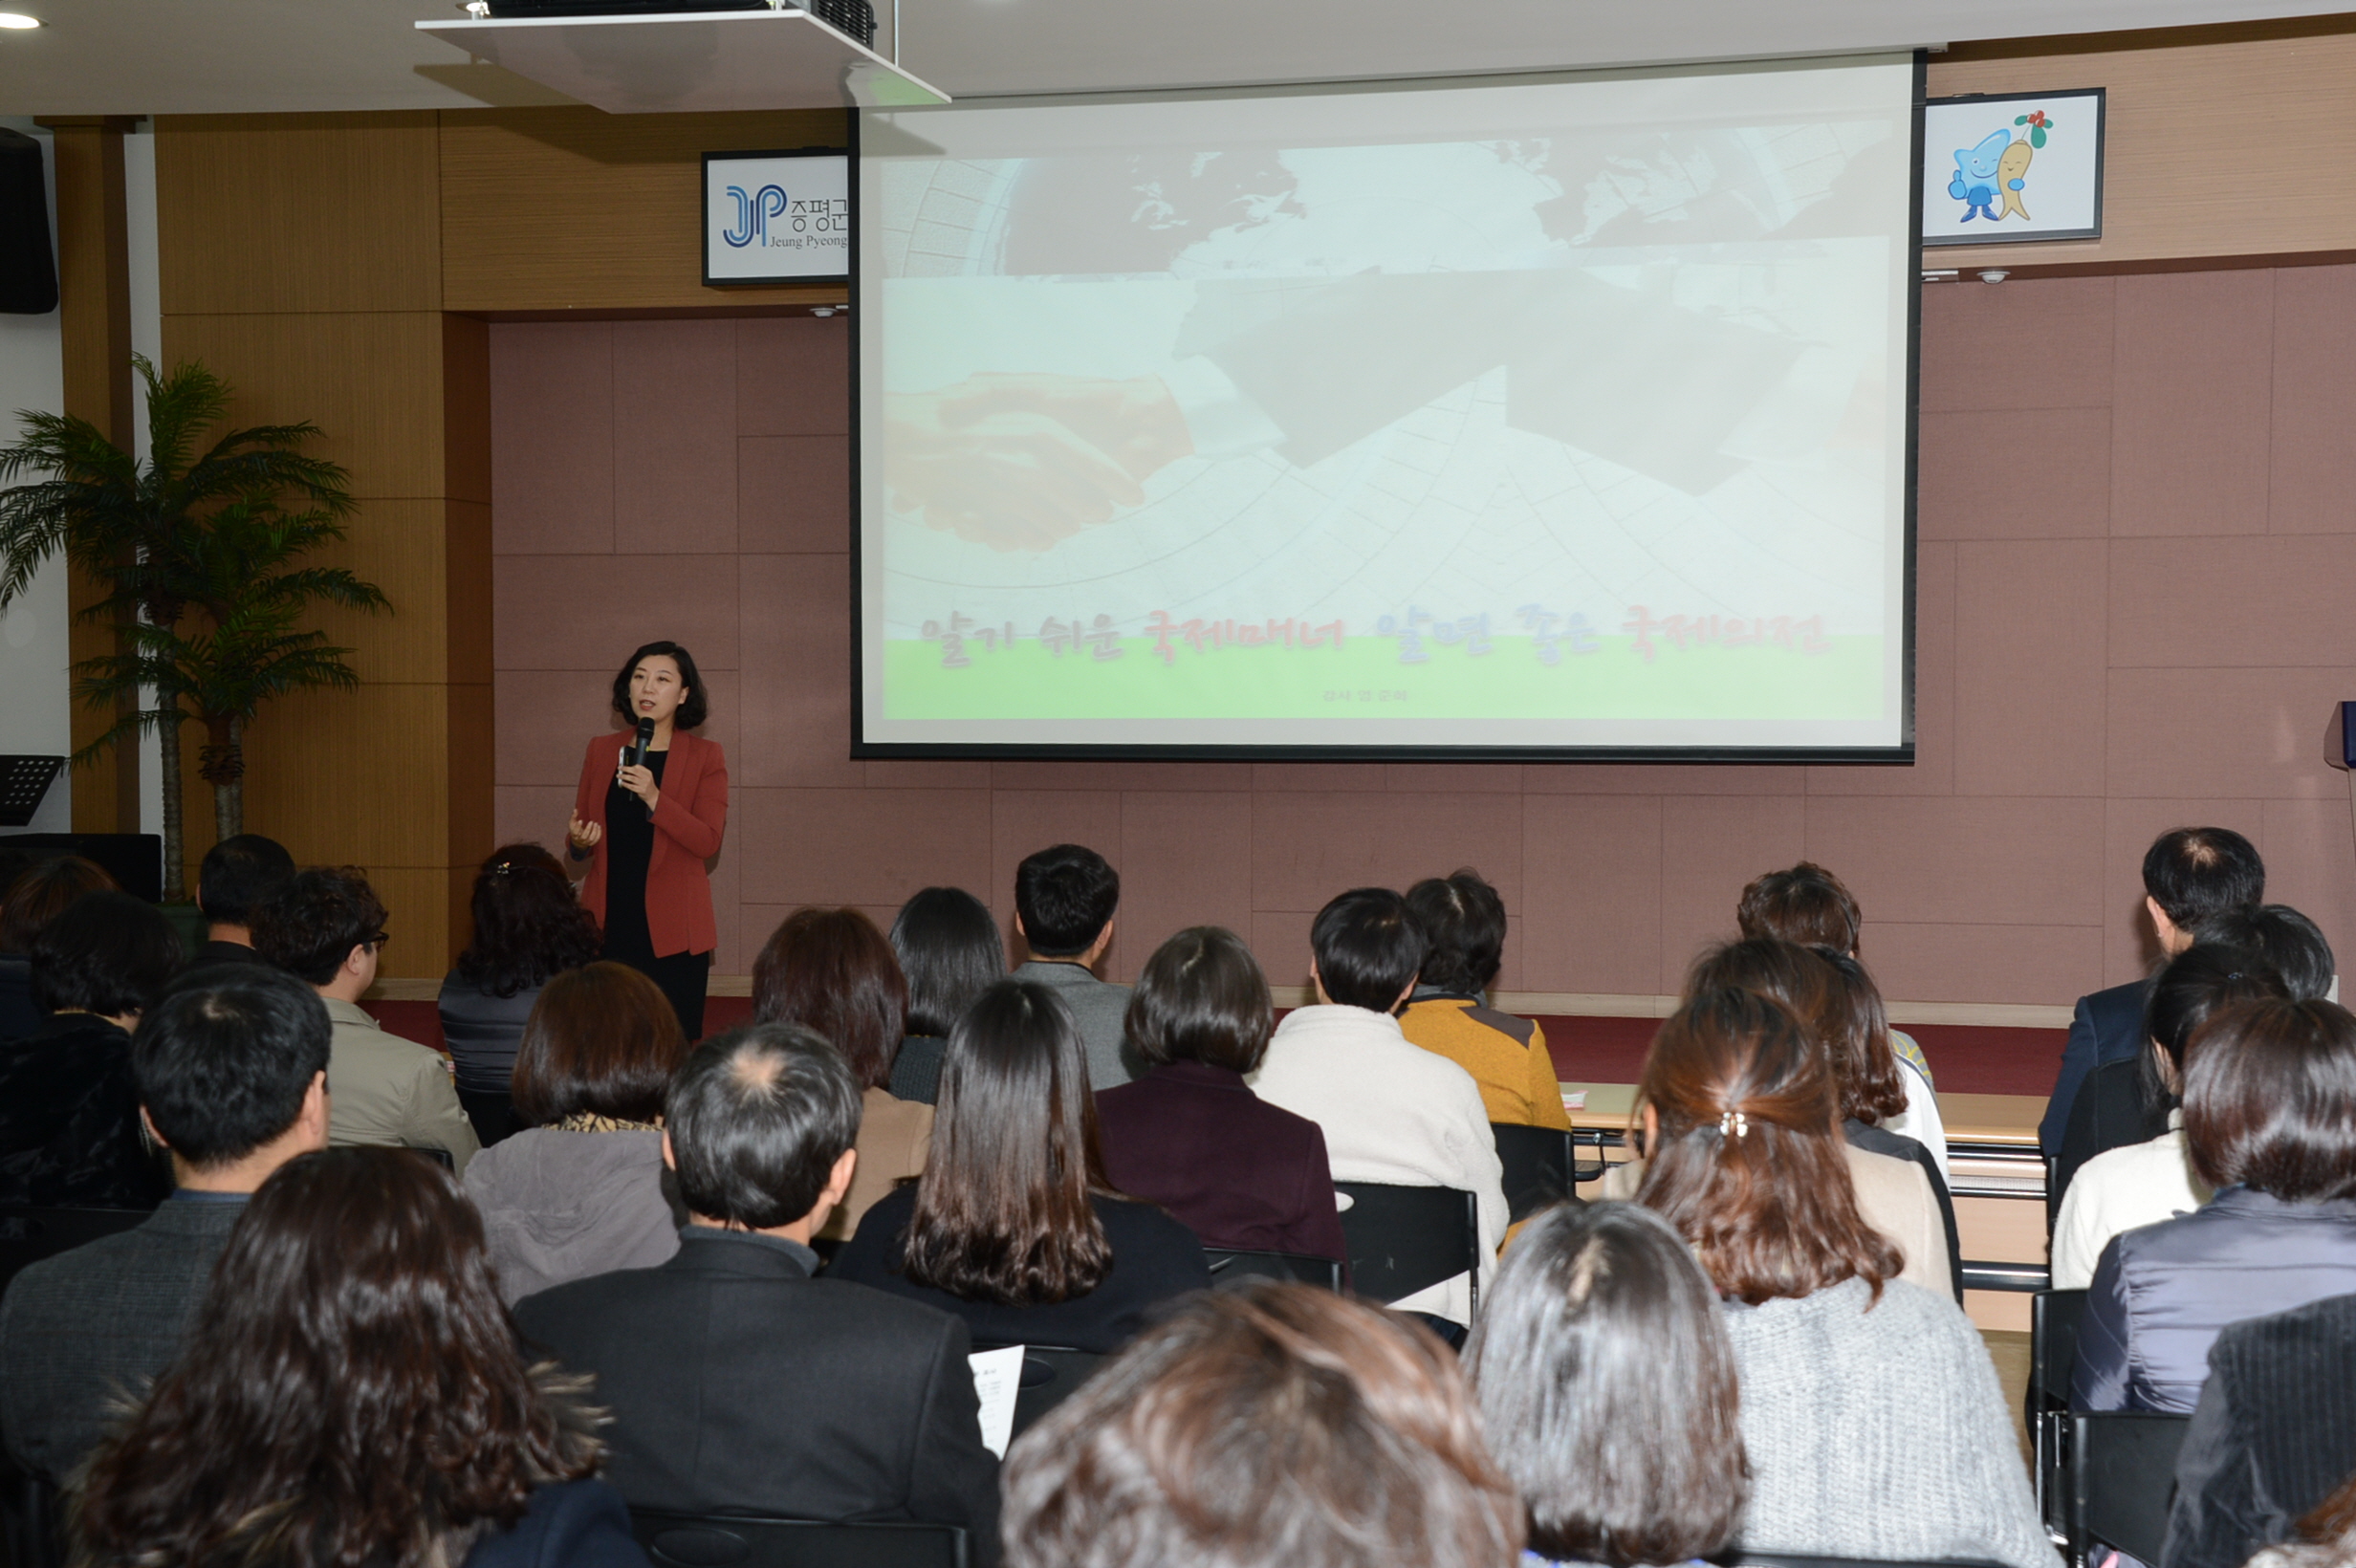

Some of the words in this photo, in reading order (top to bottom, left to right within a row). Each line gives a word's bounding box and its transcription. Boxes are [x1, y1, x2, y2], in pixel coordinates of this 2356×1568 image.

[791, 199, 848, 232] 증평군
[770, 235, 802, 250] Jeung
[806, 235, 848, 249] Pyeong
[921, 610, 1014, 667] 알기
[1038, 613, 1123, 660] 쉬운
[1144, 609, 1344, 664] 국제매너
[1375, 604, 1494, 663] 알면
[1516, 602, 1601, 664] 좋은
[1622, 604, 1833, 663] 국제의전
